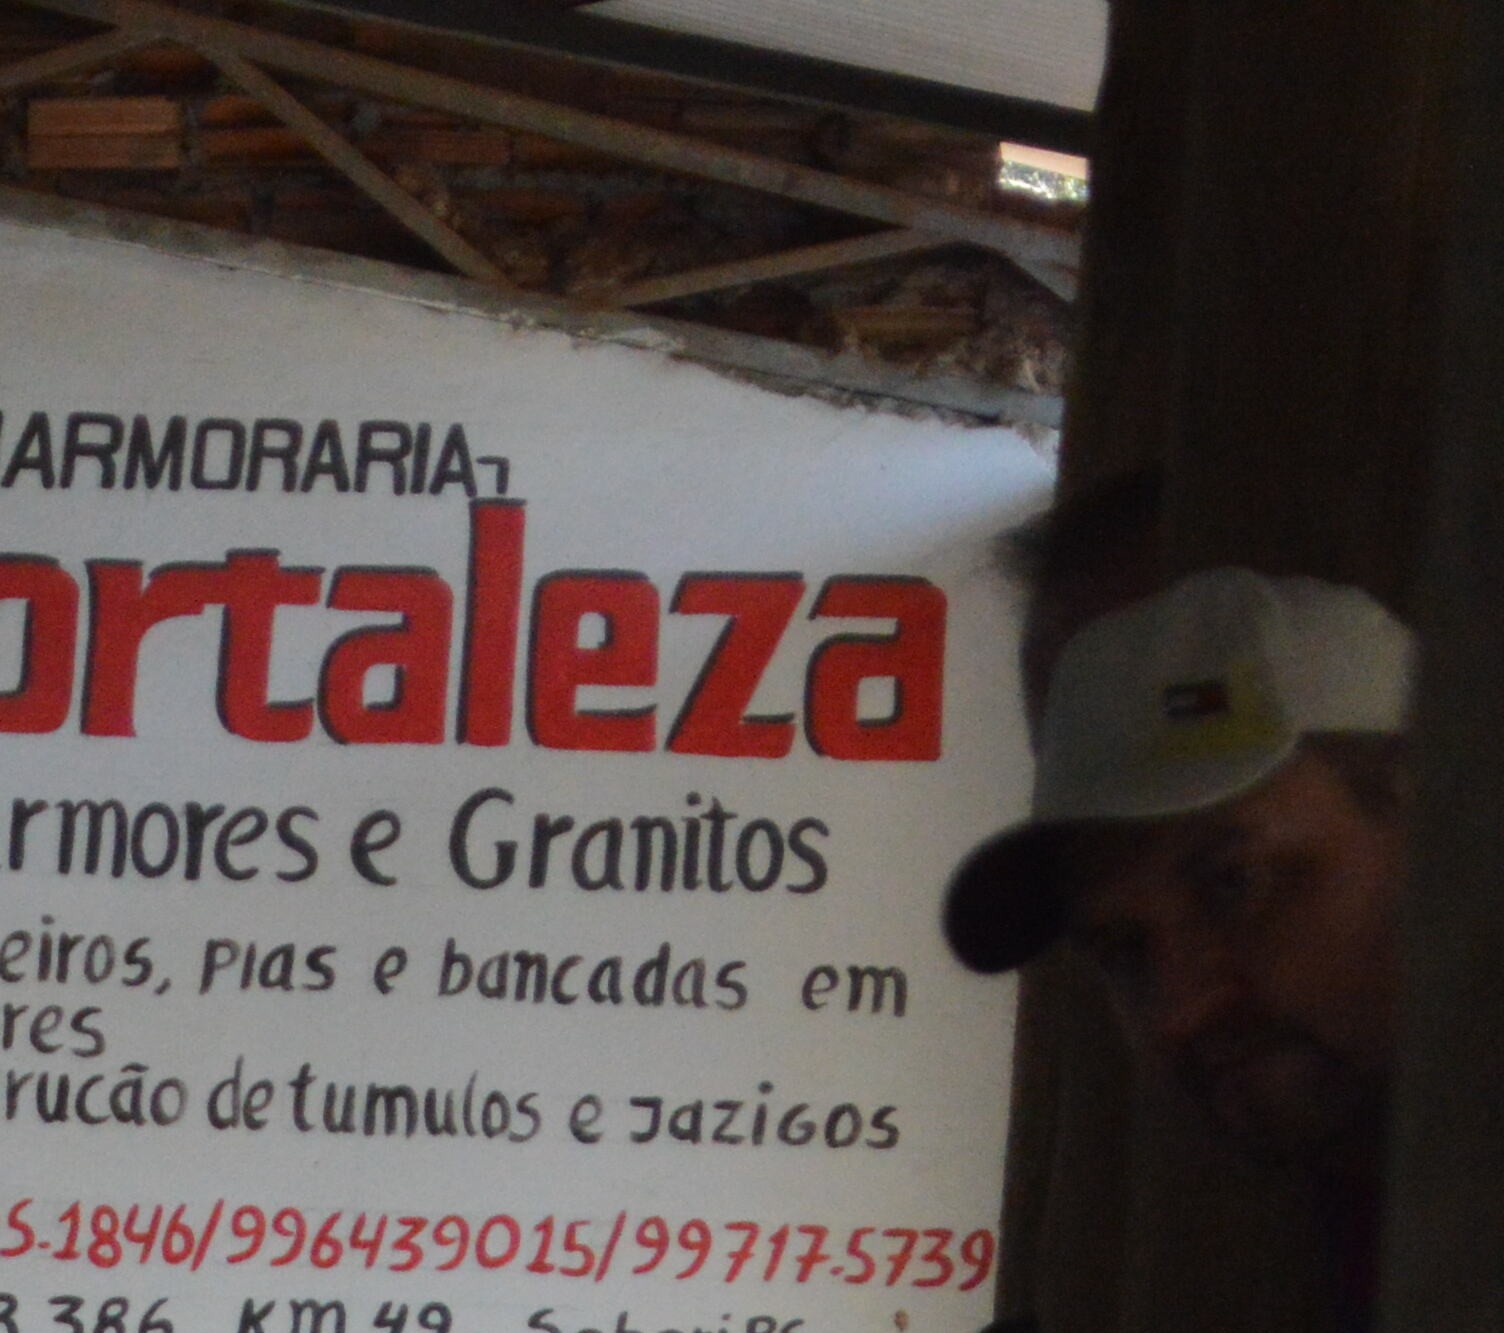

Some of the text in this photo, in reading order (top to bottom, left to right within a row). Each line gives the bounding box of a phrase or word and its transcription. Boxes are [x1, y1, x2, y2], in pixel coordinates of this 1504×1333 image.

[350, 810, 401, 887] e
[448, 786, 830, 894] Granitos
[373, 944, 408, 995] e
[438, 937, 748, 1011] bancadas
[801, 964, 909, 1017] em
[207, 1055, 275, 1131] de
[290, 1061, 542, 1143] tumulos
[569, 1093, 605, 1144] e
